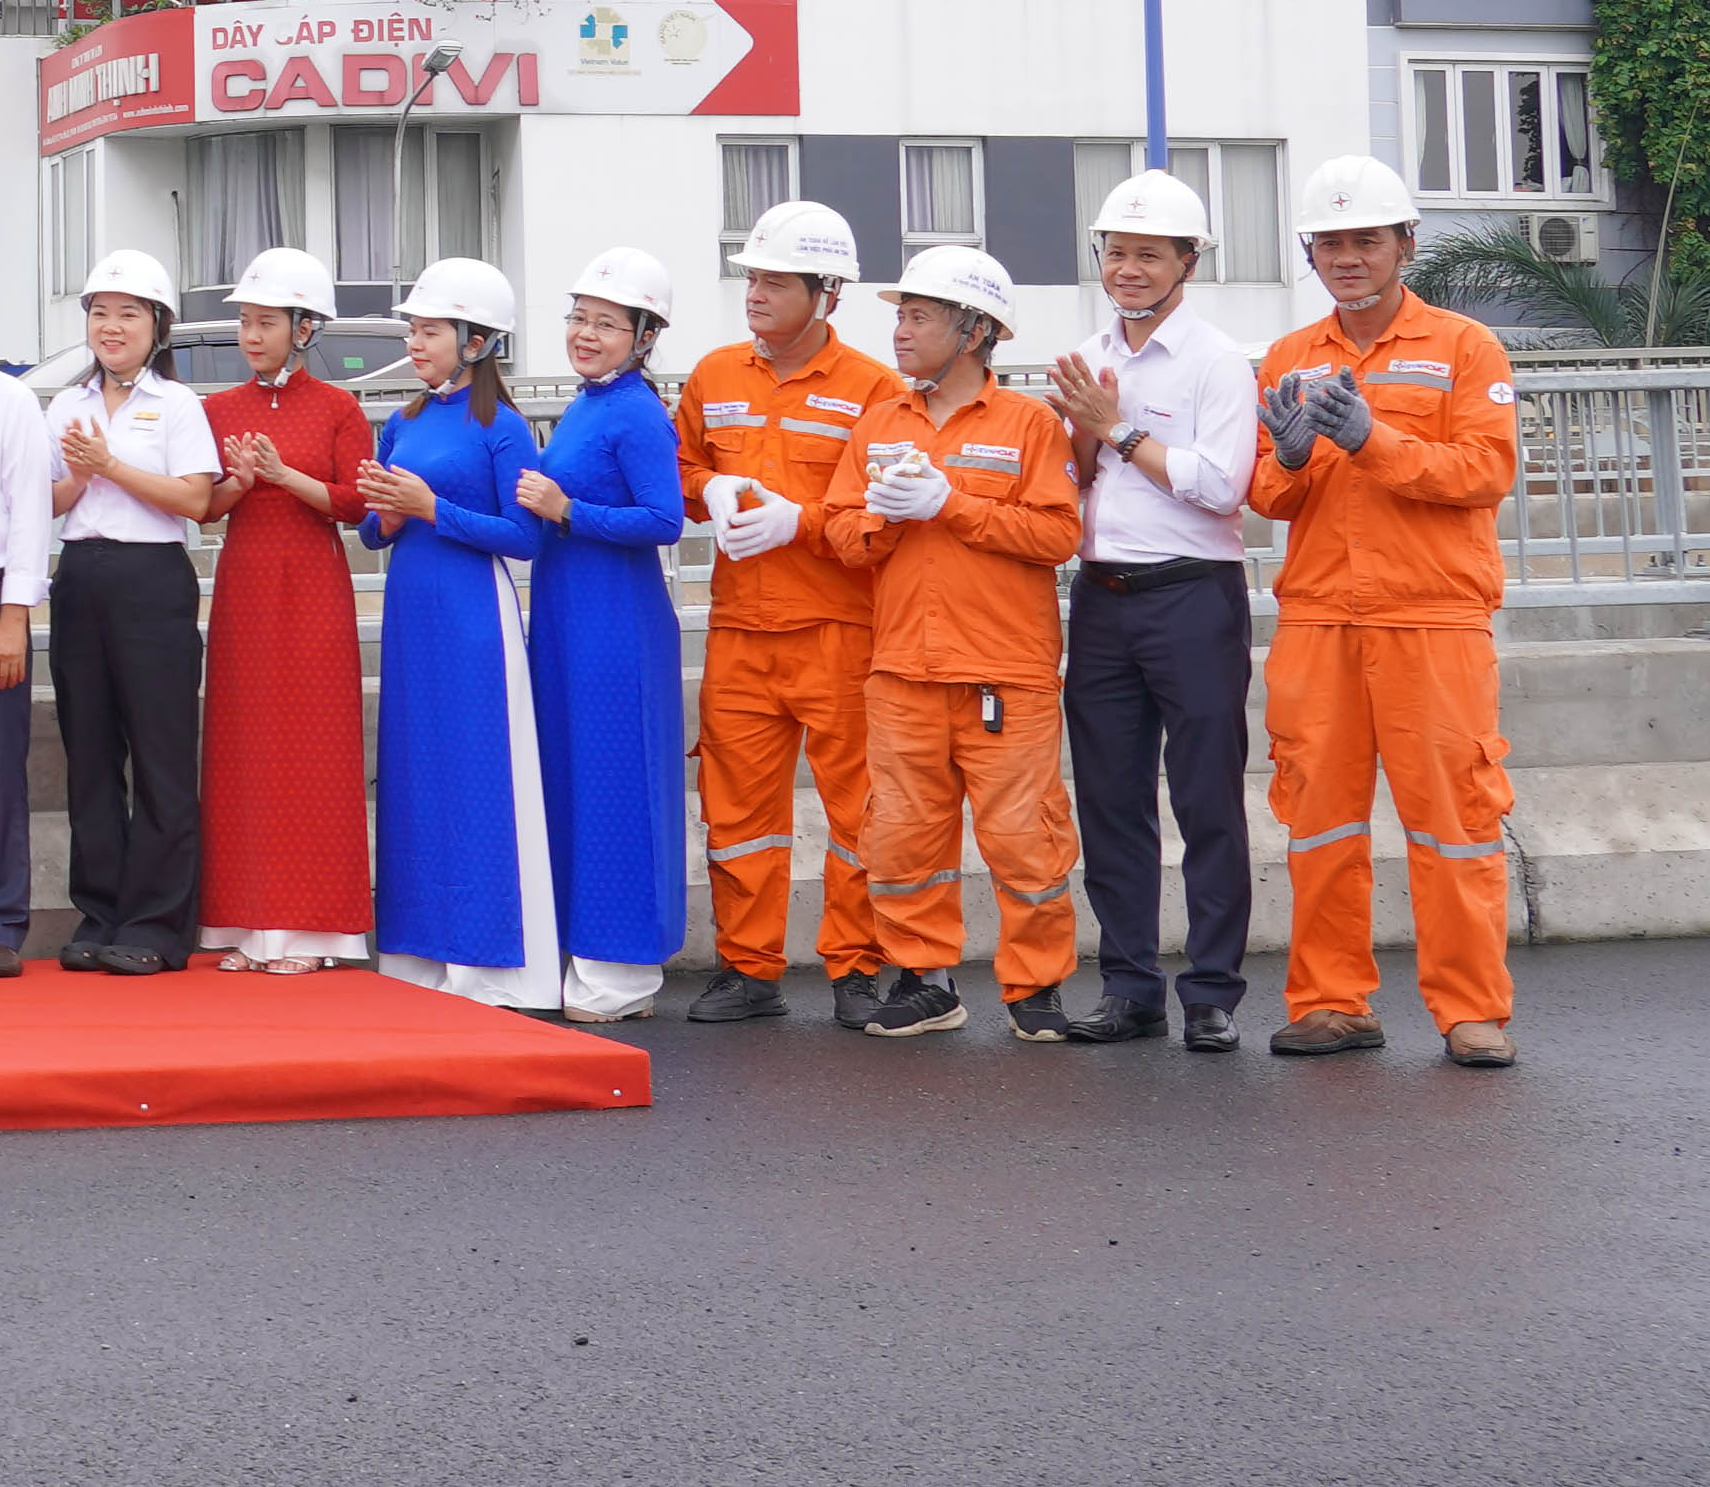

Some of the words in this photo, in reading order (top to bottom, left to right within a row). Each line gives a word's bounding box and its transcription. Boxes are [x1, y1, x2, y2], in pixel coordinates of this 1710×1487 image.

[212, 19, 264, 50] DÂY
[351, 12, 432, 47] ĐIỆN
[211, 53, 539, 112] CADIVI
